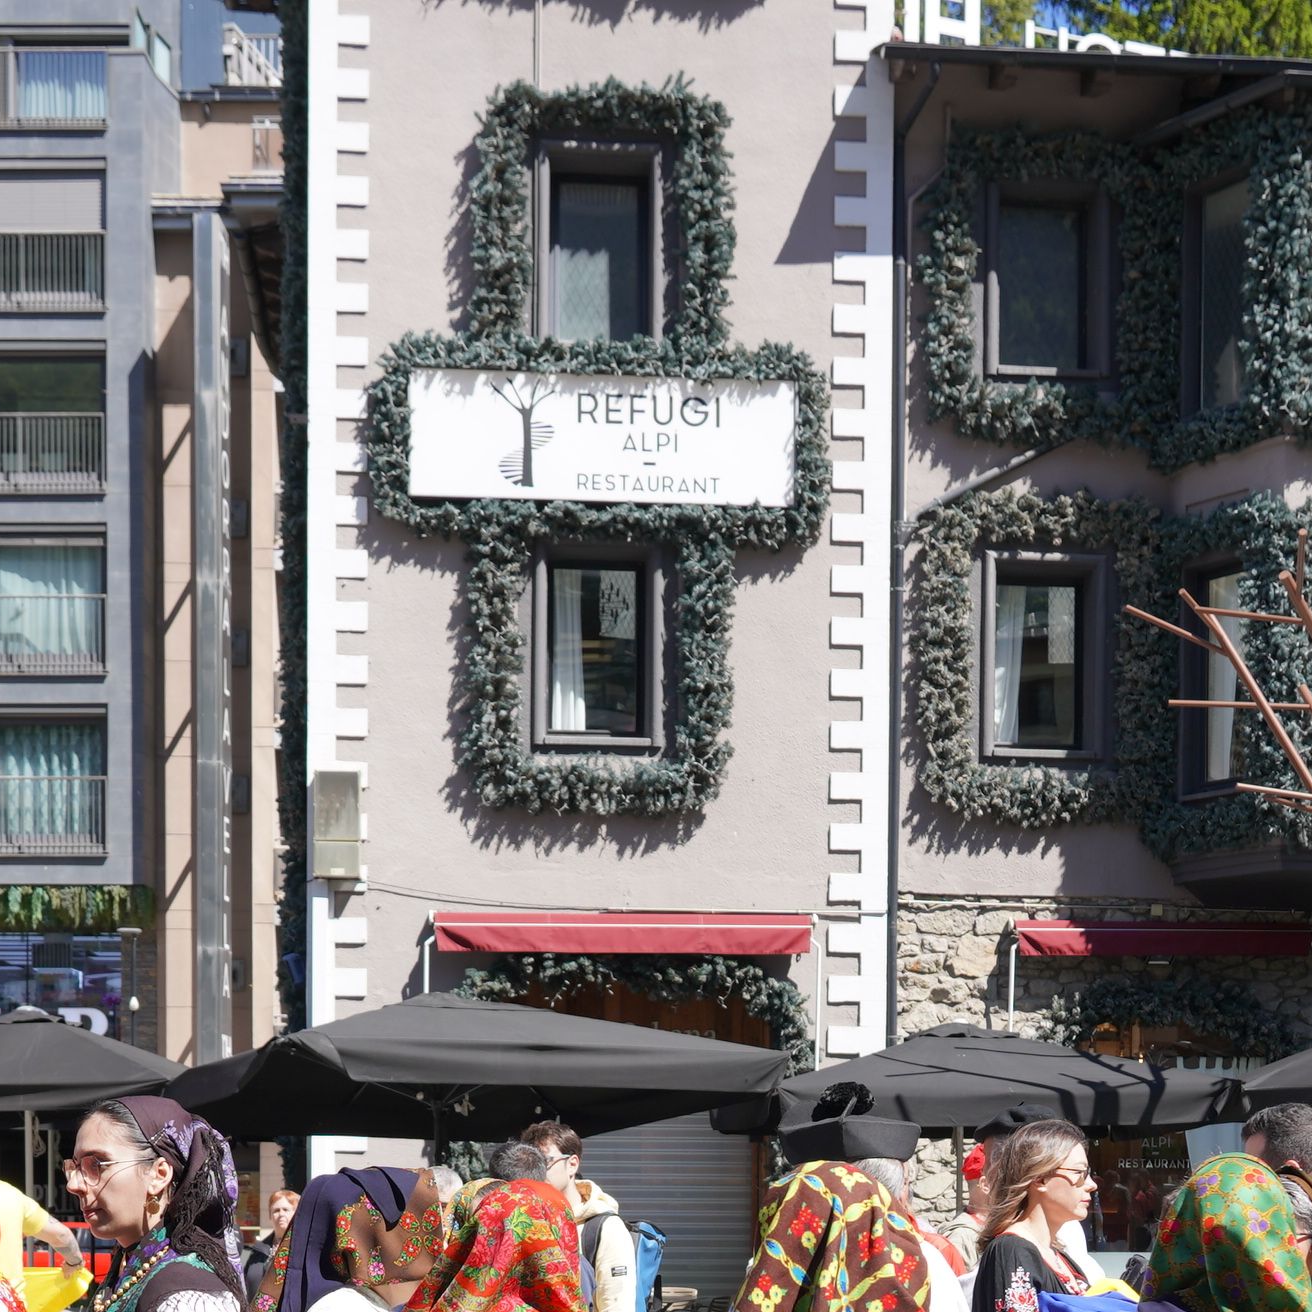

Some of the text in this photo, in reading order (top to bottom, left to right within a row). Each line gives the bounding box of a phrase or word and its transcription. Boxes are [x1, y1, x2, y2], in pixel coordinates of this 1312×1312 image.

[577, 393, 721, 428] REFUGI
[577, 473, 721, 495] RESTAURANT
[222, 768, 231, 998] VELLA
